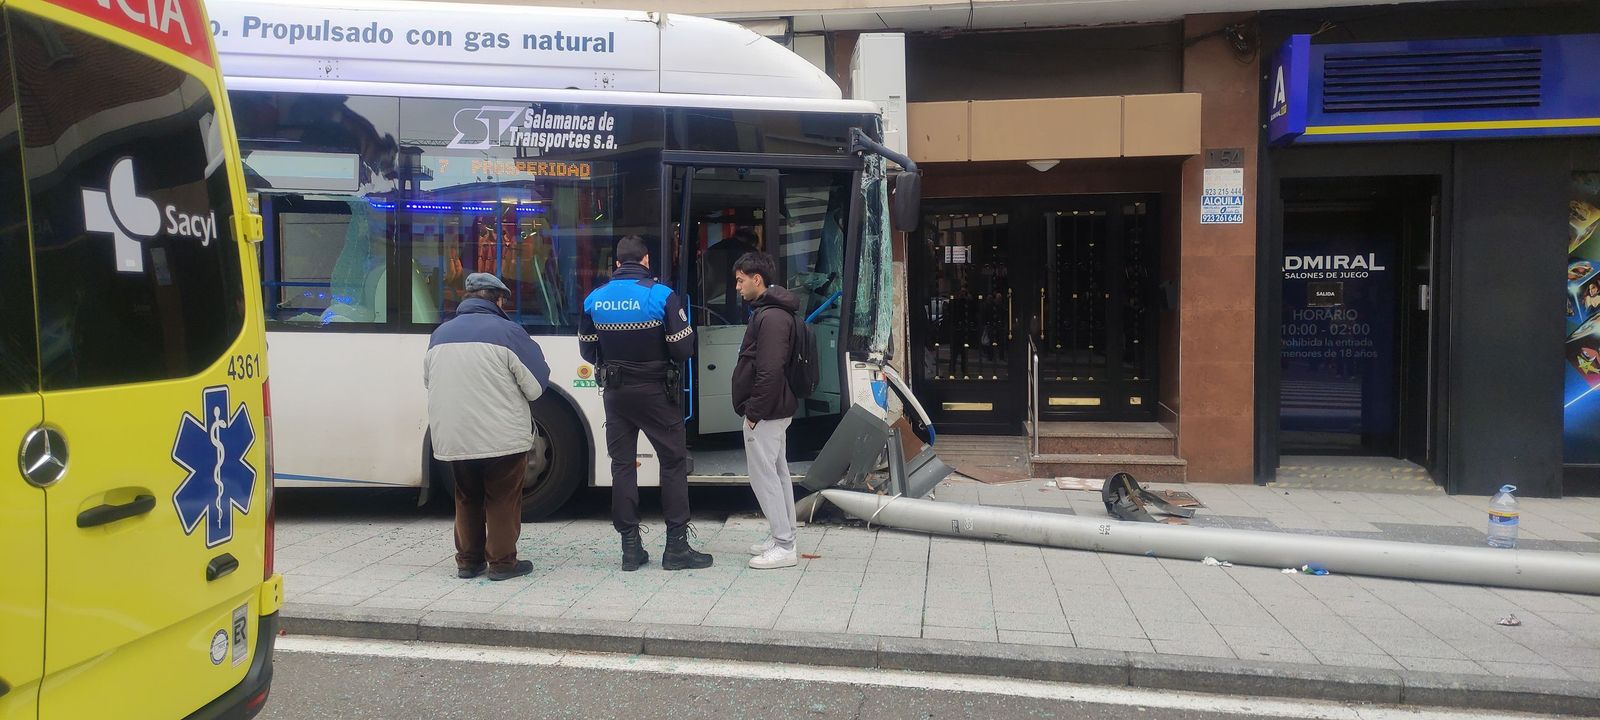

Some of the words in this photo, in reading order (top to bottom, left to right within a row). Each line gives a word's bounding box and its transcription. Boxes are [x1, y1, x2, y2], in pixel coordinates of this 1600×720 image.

[209, 20, 229, 37] o.
[242, 15, 394, 45] Propulsado
[406, 28, 452, 47] con
[463, 31, 511, 52] gas
[522, 30, 615, 53] natural
[523, 107, 596, 131] Salamanca
[598, 111, 615, 132] de
[509, 126, 591, 152] Transportes
[593, 134, 618, 150] s.a.
[470, 160, 592, 177] PROSPERIDAD
[1205, 188, 1217, 196] 923
[1230, 187, 1241, 195] 444
[1203, 196, 1242, 205] ALQUILA
[165, 204, 217, 247] Sacyl
[1325, 271, 1338, 279] DE
[1339, 271, 1369, 279] JUEGO
[594, 298, 641, 311] POLICÍA
[1293, 309, 1358, 321] HORARIO
[1281, 323, 1317, 336] 10:00
[1329, 323, 1370, 336] 02:00
[1325, 338, 1334, 347] la
[1335, 338, 1374, 347] entrada
[1324, 349, 1337, 358] de
[1341, 349, 1352, 358] 18
[1354, 349, 1378, 358] años
[227, 353, 260, 381] 4361
